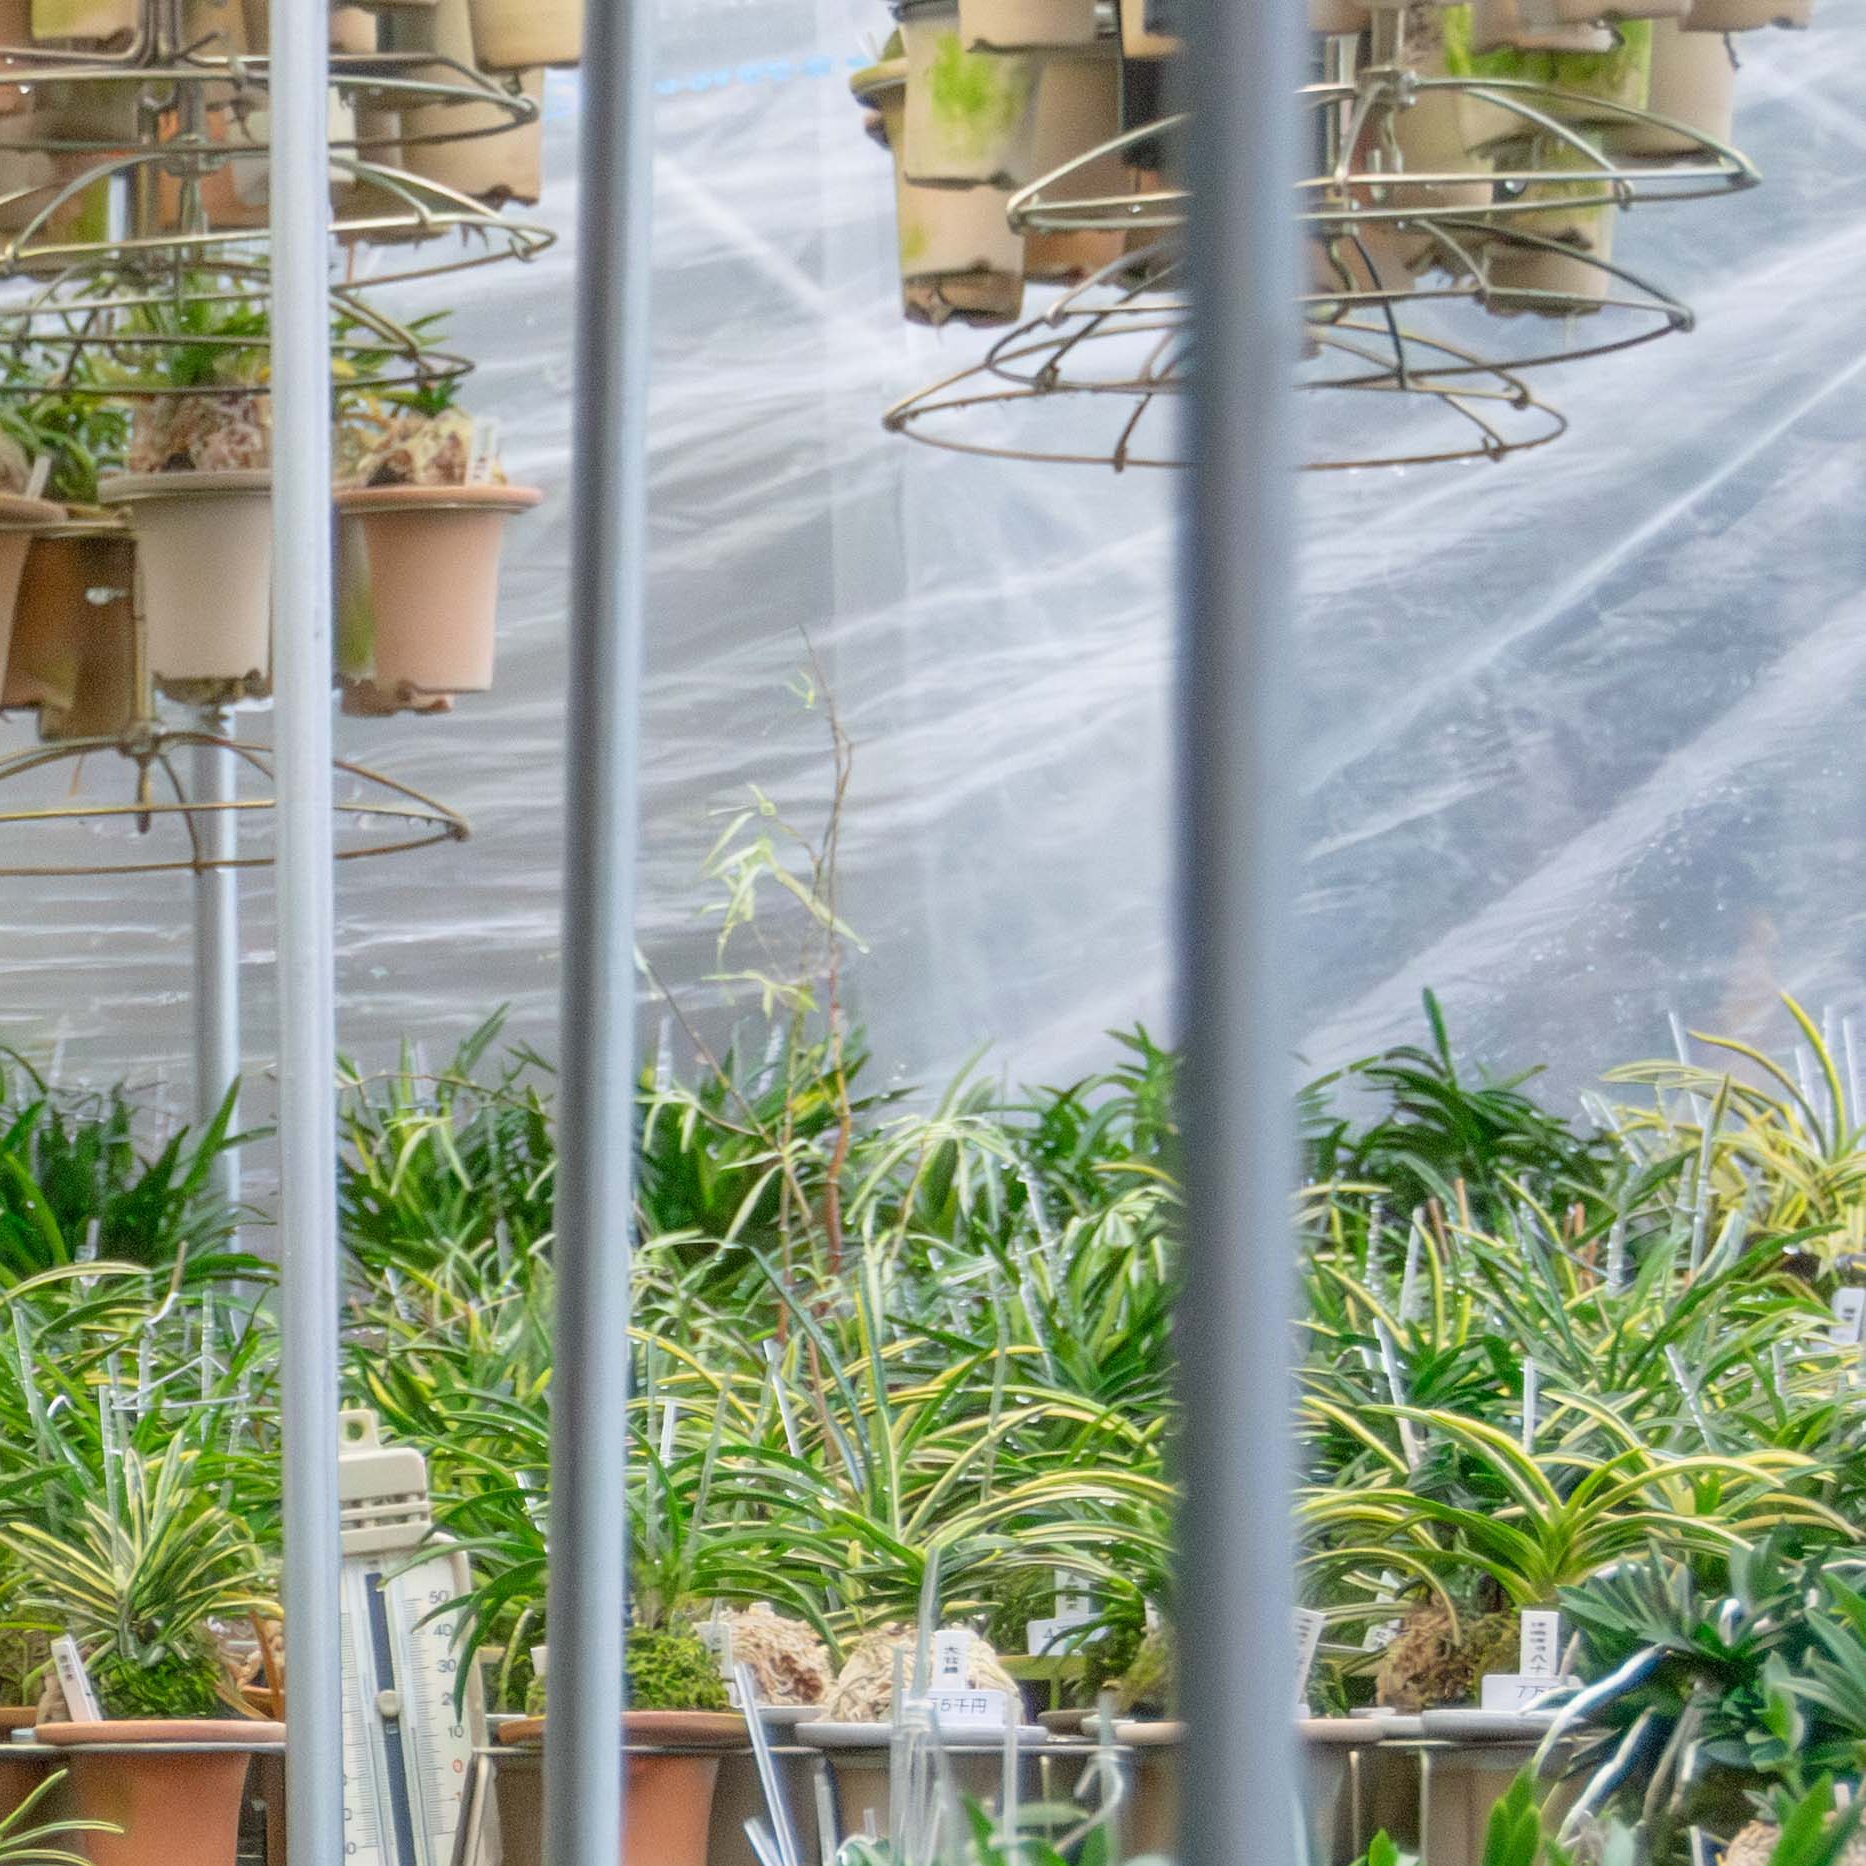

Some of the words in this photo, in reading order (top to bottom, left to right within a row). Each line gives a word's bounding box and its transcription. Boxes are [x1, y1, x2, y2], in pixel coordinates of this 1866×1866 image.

[429, 1590, 449, 1604] 50
[433, 1623, 453, 1637] 40
[437, 1659, 457, 1673] 30
[448, 1725, 464, 1738] 10
[452, 1759, 463, 1773] 0
